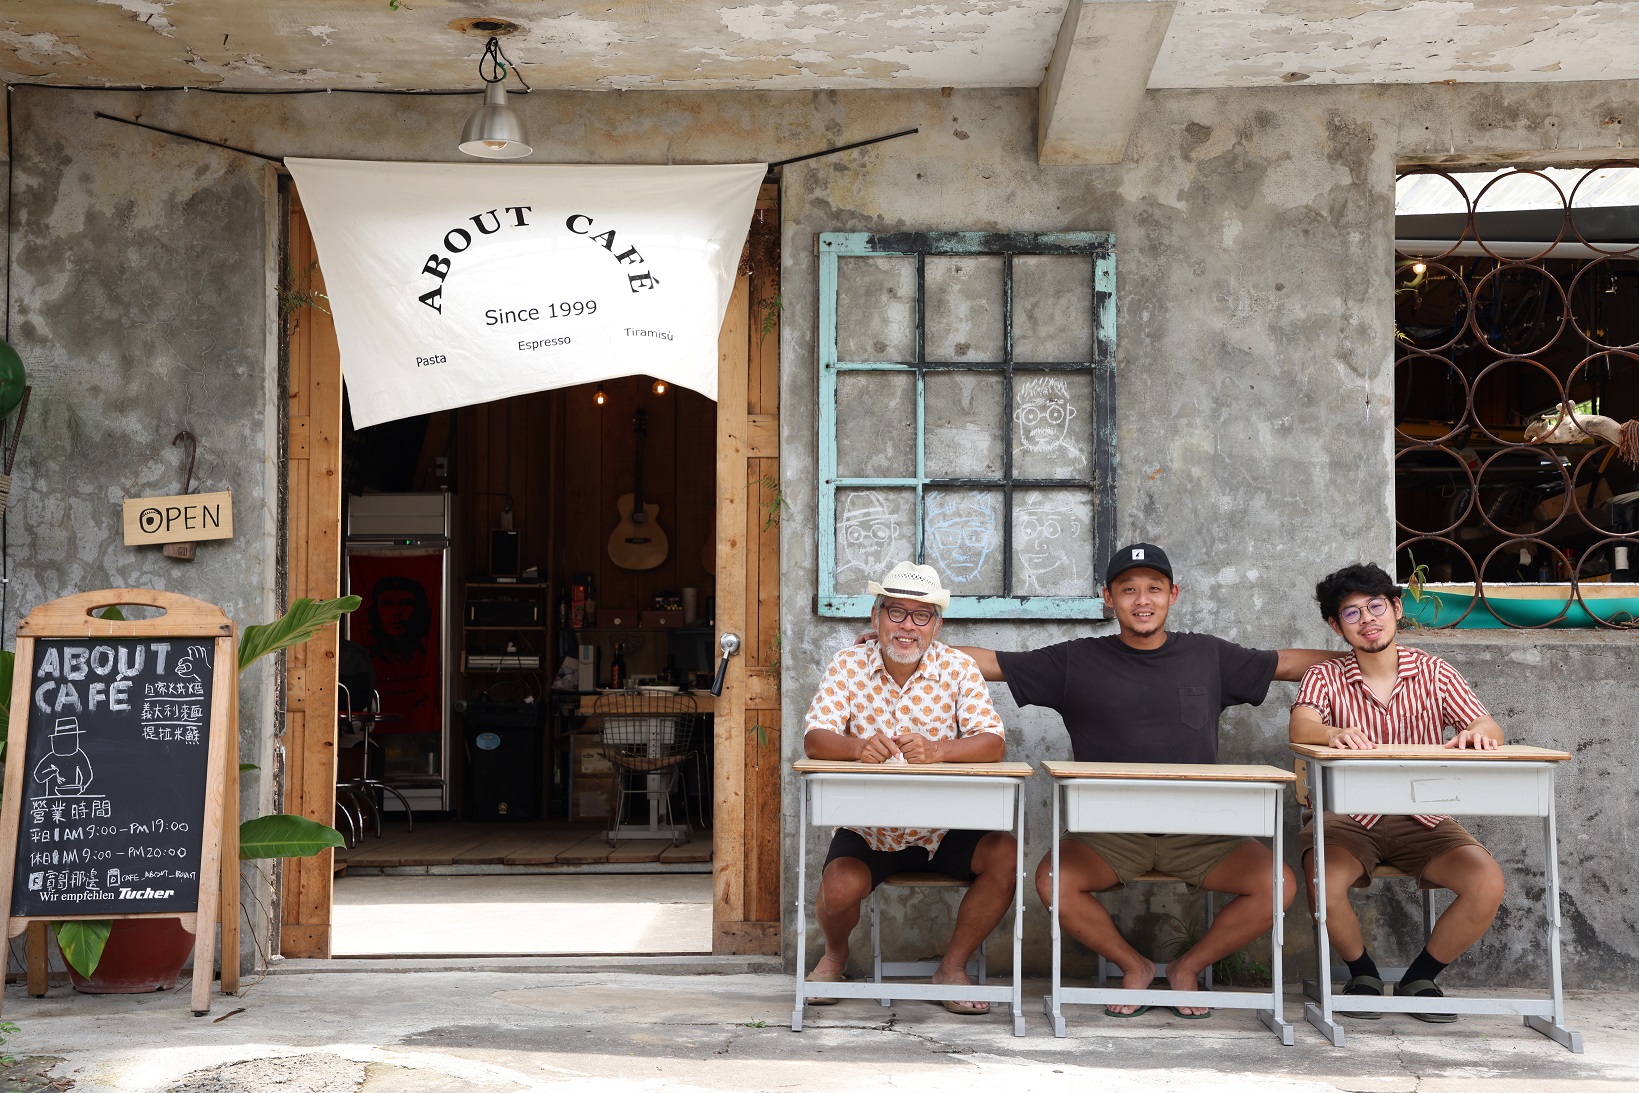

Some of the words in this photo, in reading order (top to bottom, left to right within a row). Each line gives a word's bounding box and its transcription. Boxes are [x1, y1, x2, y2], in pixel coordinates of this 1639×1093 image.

[418, 206, 532, 315] ABOUT
[565, 214, 660, 293] CAFÉ
[485, 307, 540, 326] Since
[548, 300, 598, 319] 1999
[518, 336, 571, 351] Espresso
[624, 327, 674, 341] Tiramisù
[416, 354, 447, 367] Pasta
[139, 504, 220, 533] OPEN
[37, 643, 171, 680] ABOUT
[35, 674, 133, 714] CAFÉ
[141, 702, 202, 721] 義大利麵
[30, 800, 112, 824] 營業時間
[40, 891, 59, 901] Wir
[61, 890, 115, 903] empfehlen
[118, 887, 175, 900] Tucher
